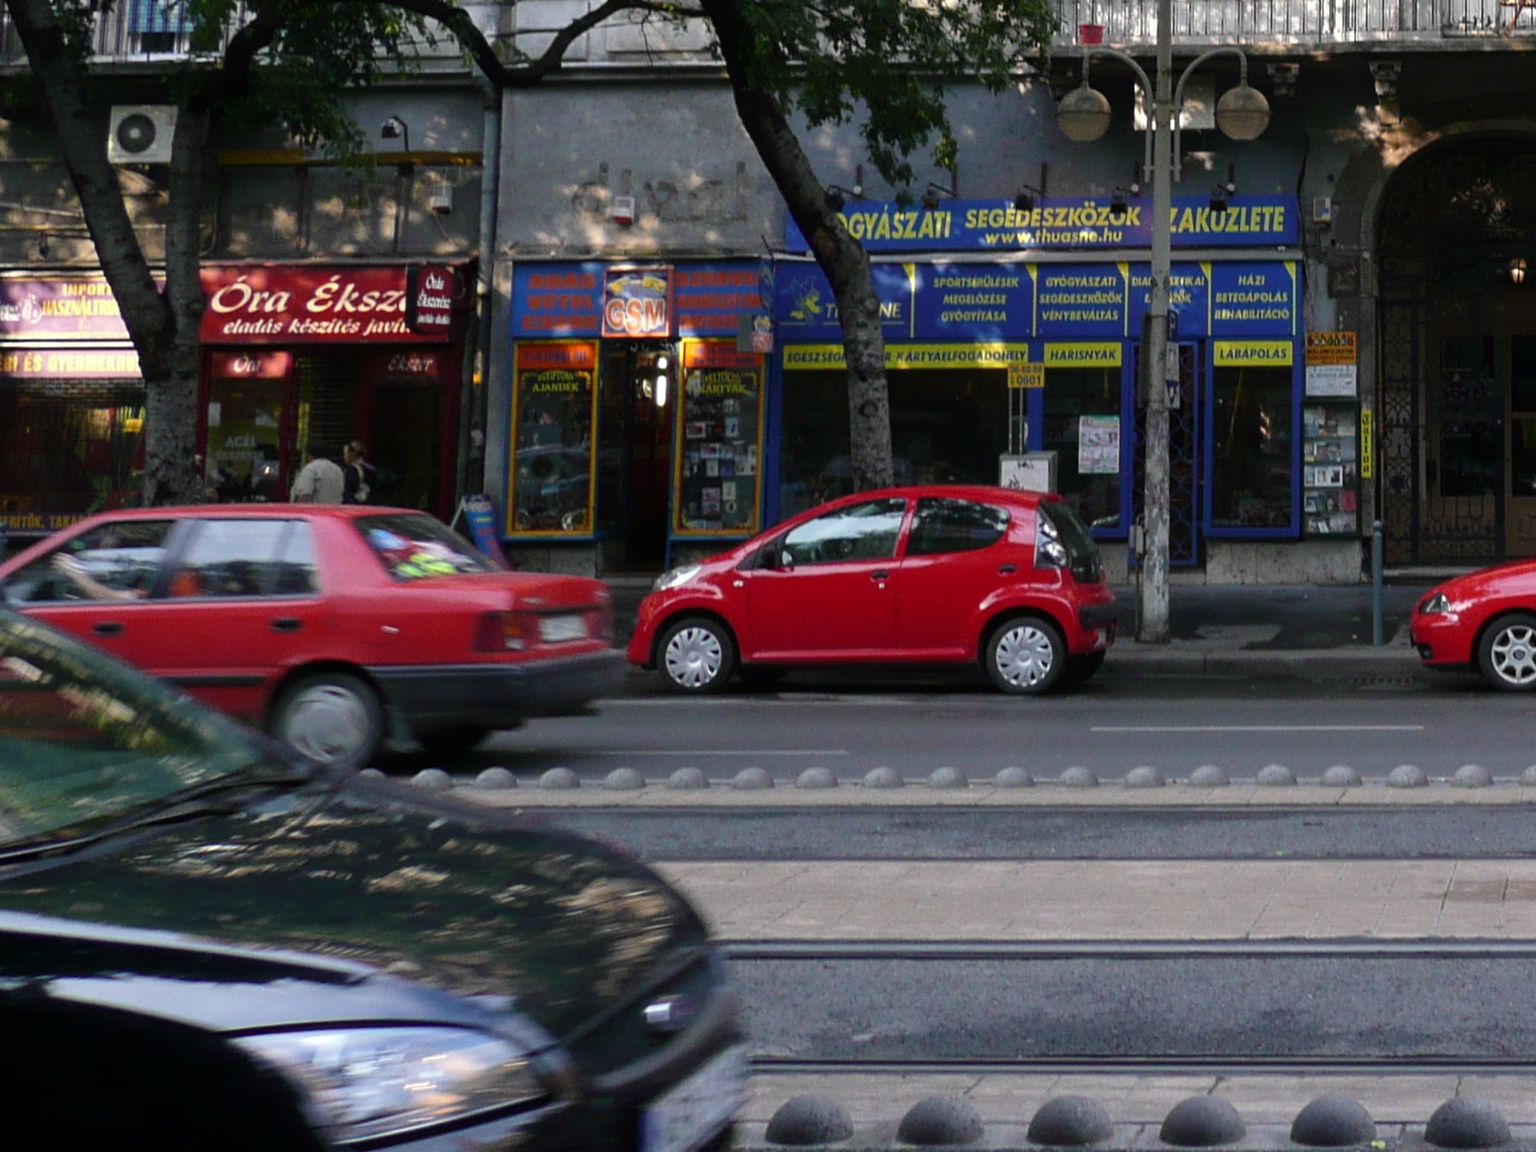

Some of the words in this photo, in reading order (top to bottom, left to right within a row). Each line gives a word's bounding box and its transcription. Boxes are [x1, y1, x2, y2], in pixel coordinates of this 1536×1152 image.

[838, 205, 951, 239] GYÁSZATI
[985, 228, 1123, 244] www.thuasne.hu
[933, 274, 1019, 289] SPORTSÉRÜLÉSEK
[1045, 275, 1117, 288] GYÓGYÁSZATI
[1237, 274, 1266, 286] HÁZI
[211, 275, 289, 314] Óra
[943, 292, 1007, 306] MEGELŐZÉSE
[1039, 290, 1122, 305] SEGÉDESZKÖZÖK
[1215, 290, 1288, 304] BETEGÁPOLÁS
[604, 298, 666, 334] GSM
[941, 308, 1007, 323] GYÓGYÍTÁSA
[1042, 307, 1118, 322] VÉNYBEVÁLTÁS
[1214, 306, 1290, 321] REHABILITÁCIÓ
[223, 318, 282, 335] eladás
[288, 317, 360, 335] készítés
[1050, 347, 1116, 361] HARISNYÁK
[1219, 345, 1287, 360] LÁBÁPOLÁS
[23, 351, 43, 373] ÉS
